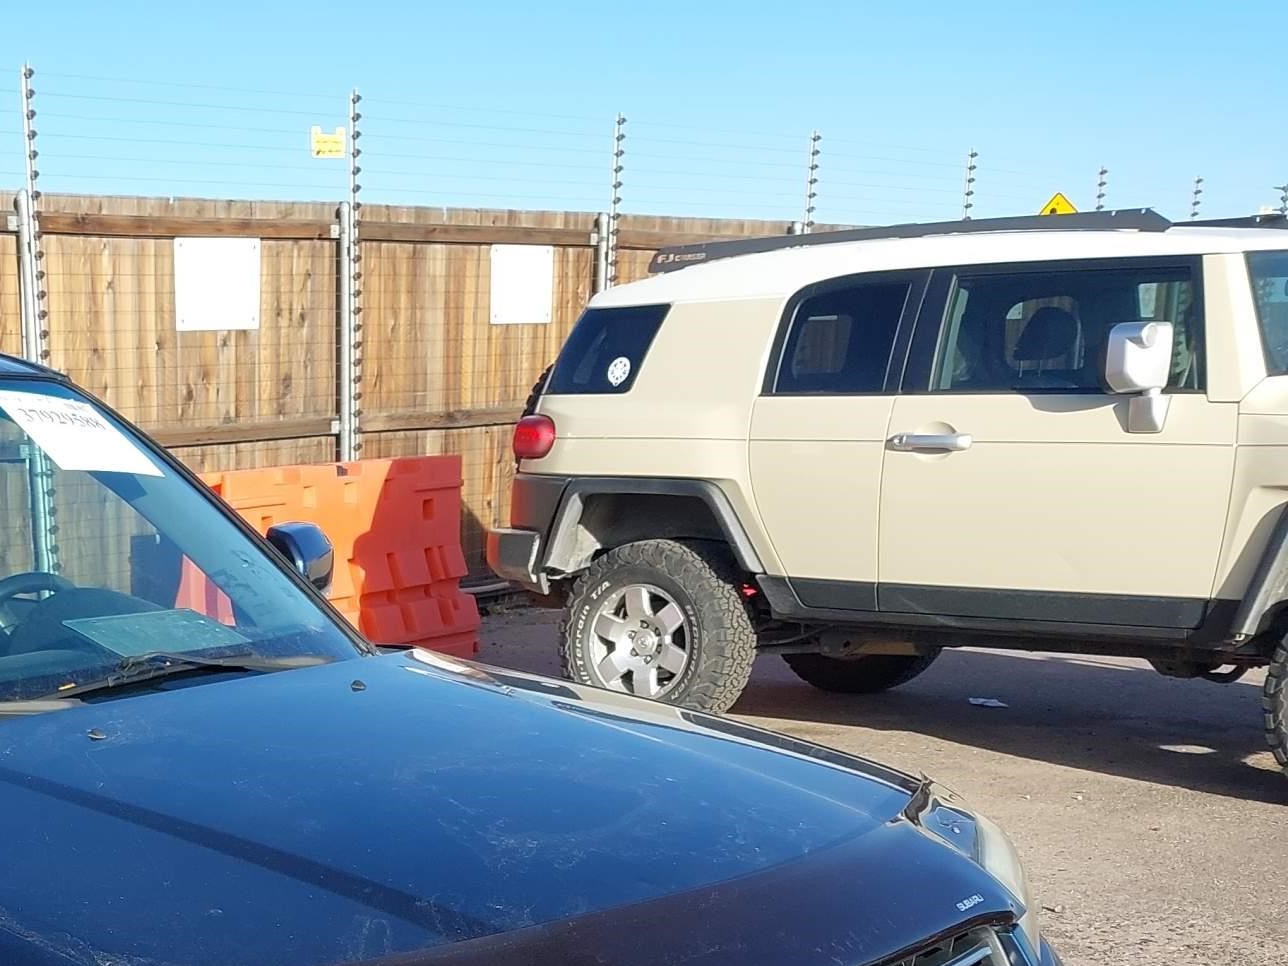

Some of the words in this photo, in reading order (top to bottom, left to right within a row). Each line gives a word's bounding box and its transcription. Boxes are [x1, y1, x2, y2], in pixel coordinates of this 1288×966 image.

[657, 253, 674, 264] FJ
[590, 580, 612, 601] T/A
[955, 893, 985, 912] SUBARU
